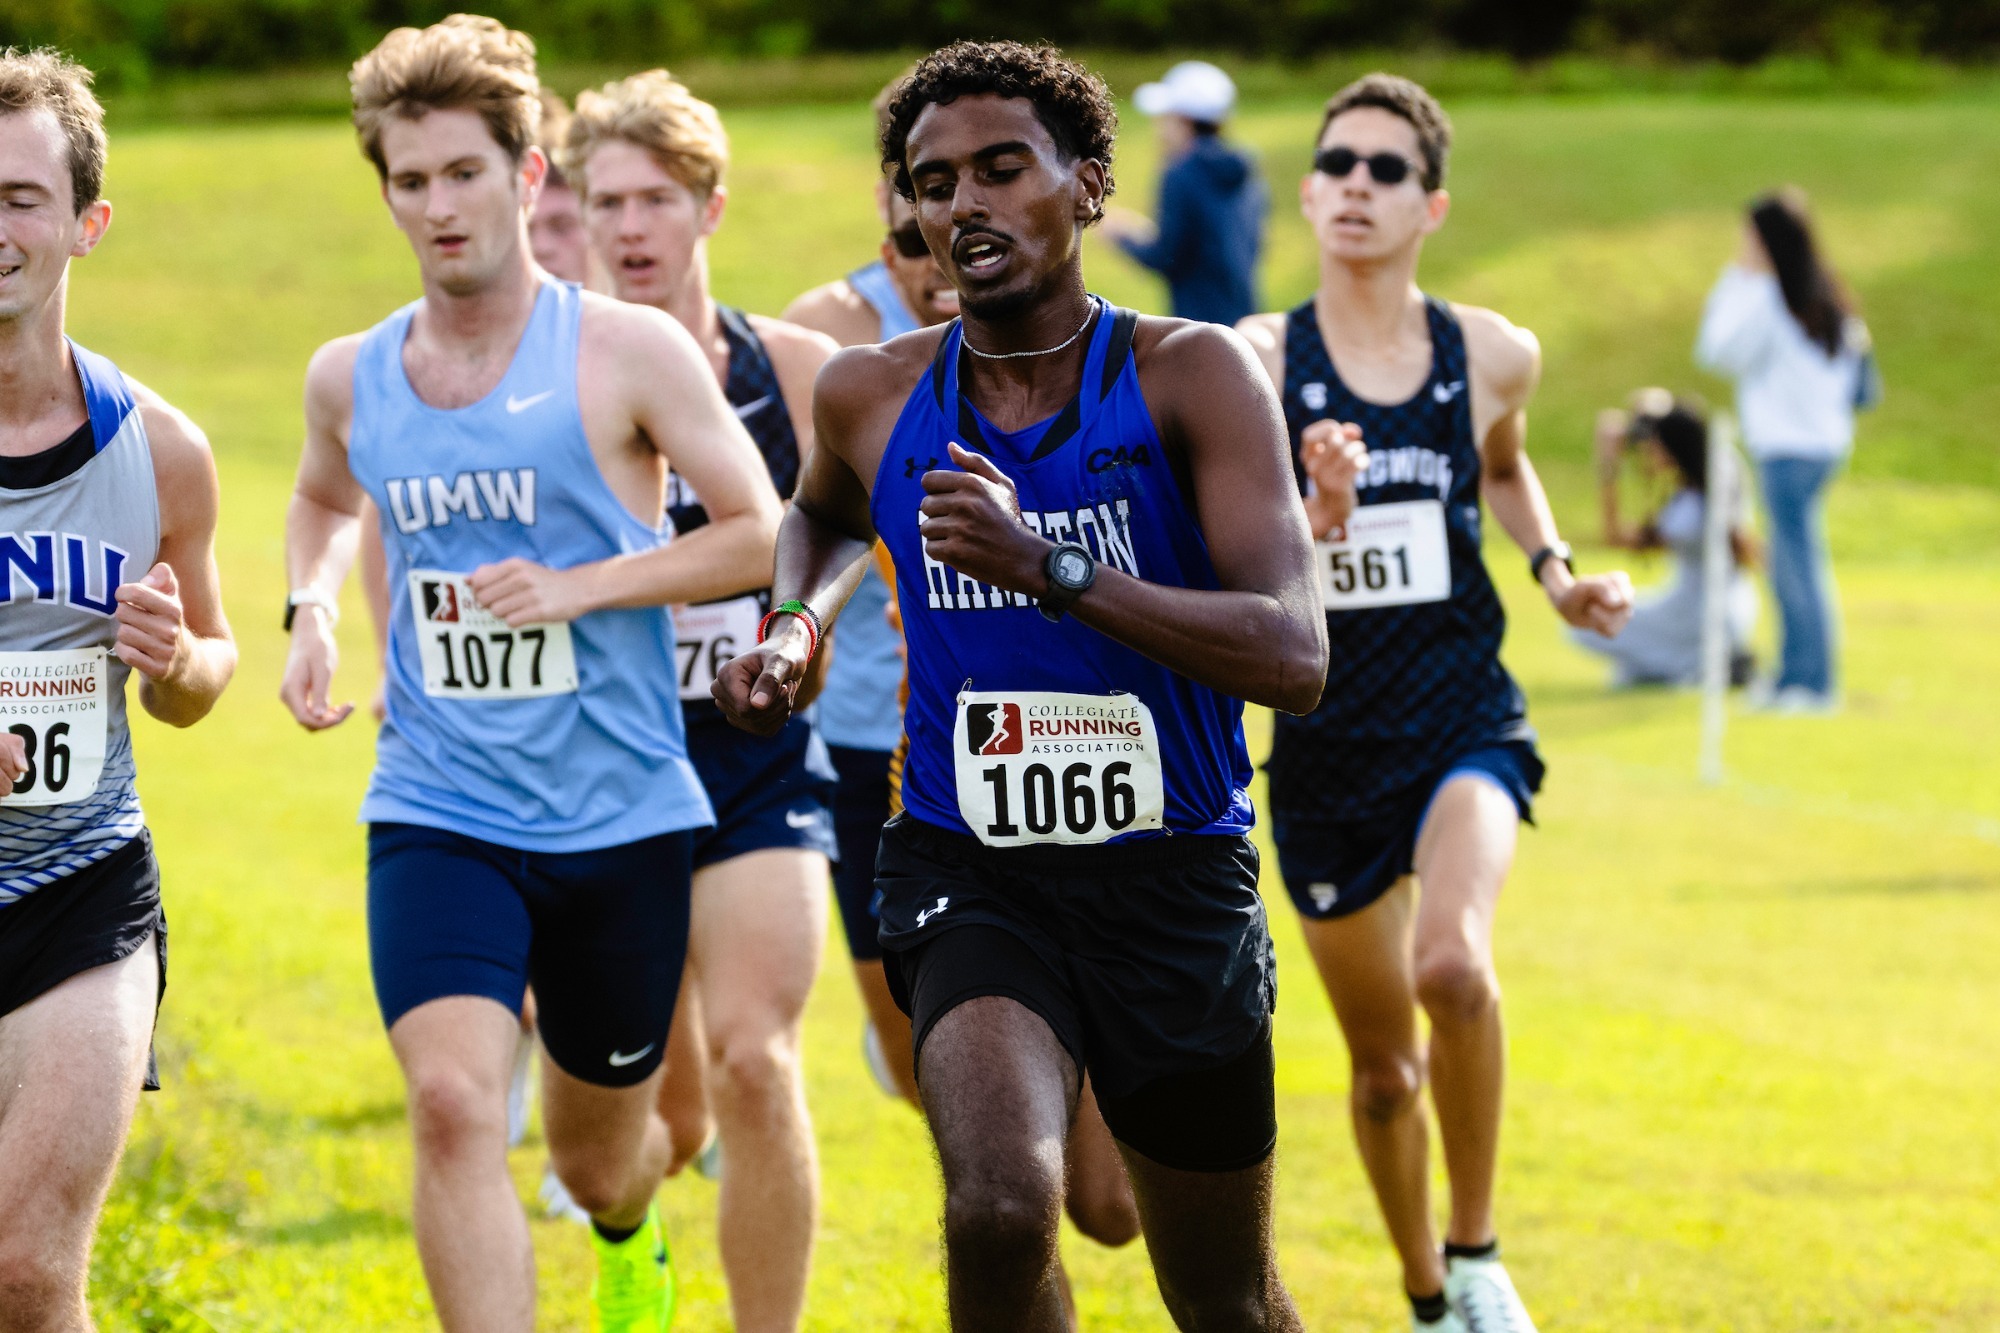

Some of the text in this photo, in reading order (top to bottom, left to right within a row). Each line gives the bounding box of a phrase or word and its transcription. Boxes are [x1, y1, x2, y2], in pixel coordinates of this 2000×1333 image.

[1087, 444, 1152, 474] CAA
[383, 467, 537, 536] UMW
[1330, 544, 1411, 595] 561
[0, 662, 96, 678] COLLEGIATE
[435, 628, 547, 690] 1077
[0, 676, 96, 698] RUNNING
[0, 701, 96, 714] ASSOCIATION
[1028, 705, 1139, 719] COLLEGIATE
[1029, 720, 1142, 737] RUNNING
[1031, 742, 1144, 754] ASSOCIATION
[983, 761, 1136, 837] 1066
